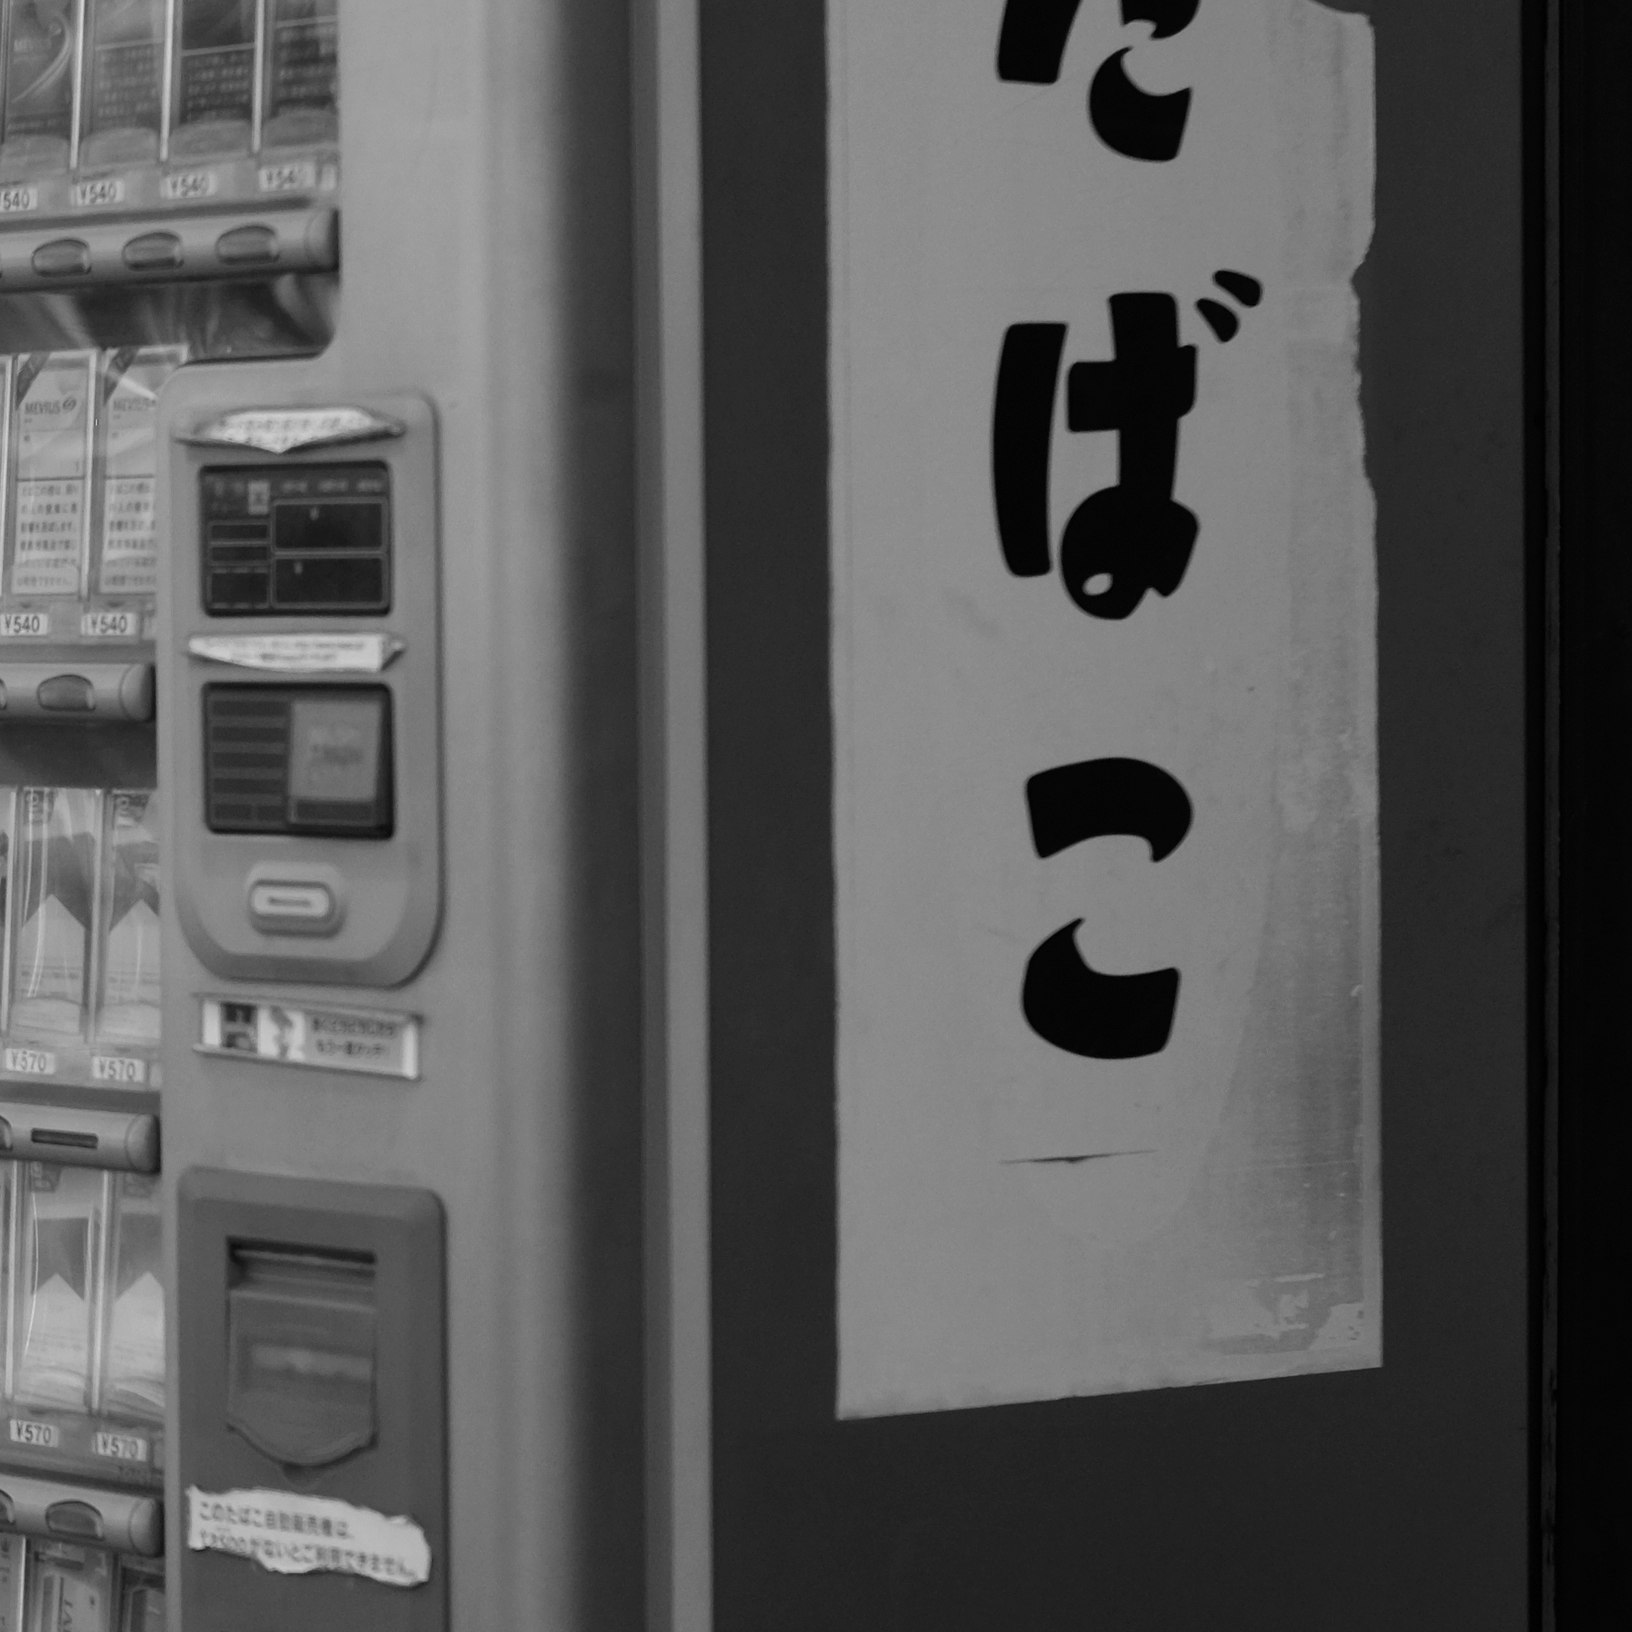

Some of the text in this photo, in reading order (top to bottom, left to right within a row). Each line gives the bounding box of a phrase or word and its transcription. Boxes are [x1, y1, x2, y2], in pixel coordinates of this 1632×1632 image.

[24, 400, 62, 416] MEVIUS
[5, 614, 40, 634] ¥540
[11, 1051, 47, 1072] ¥570
[99, 1058, 136, 1080] ¥570
[15, 1423, 52, 1444] ¥570
